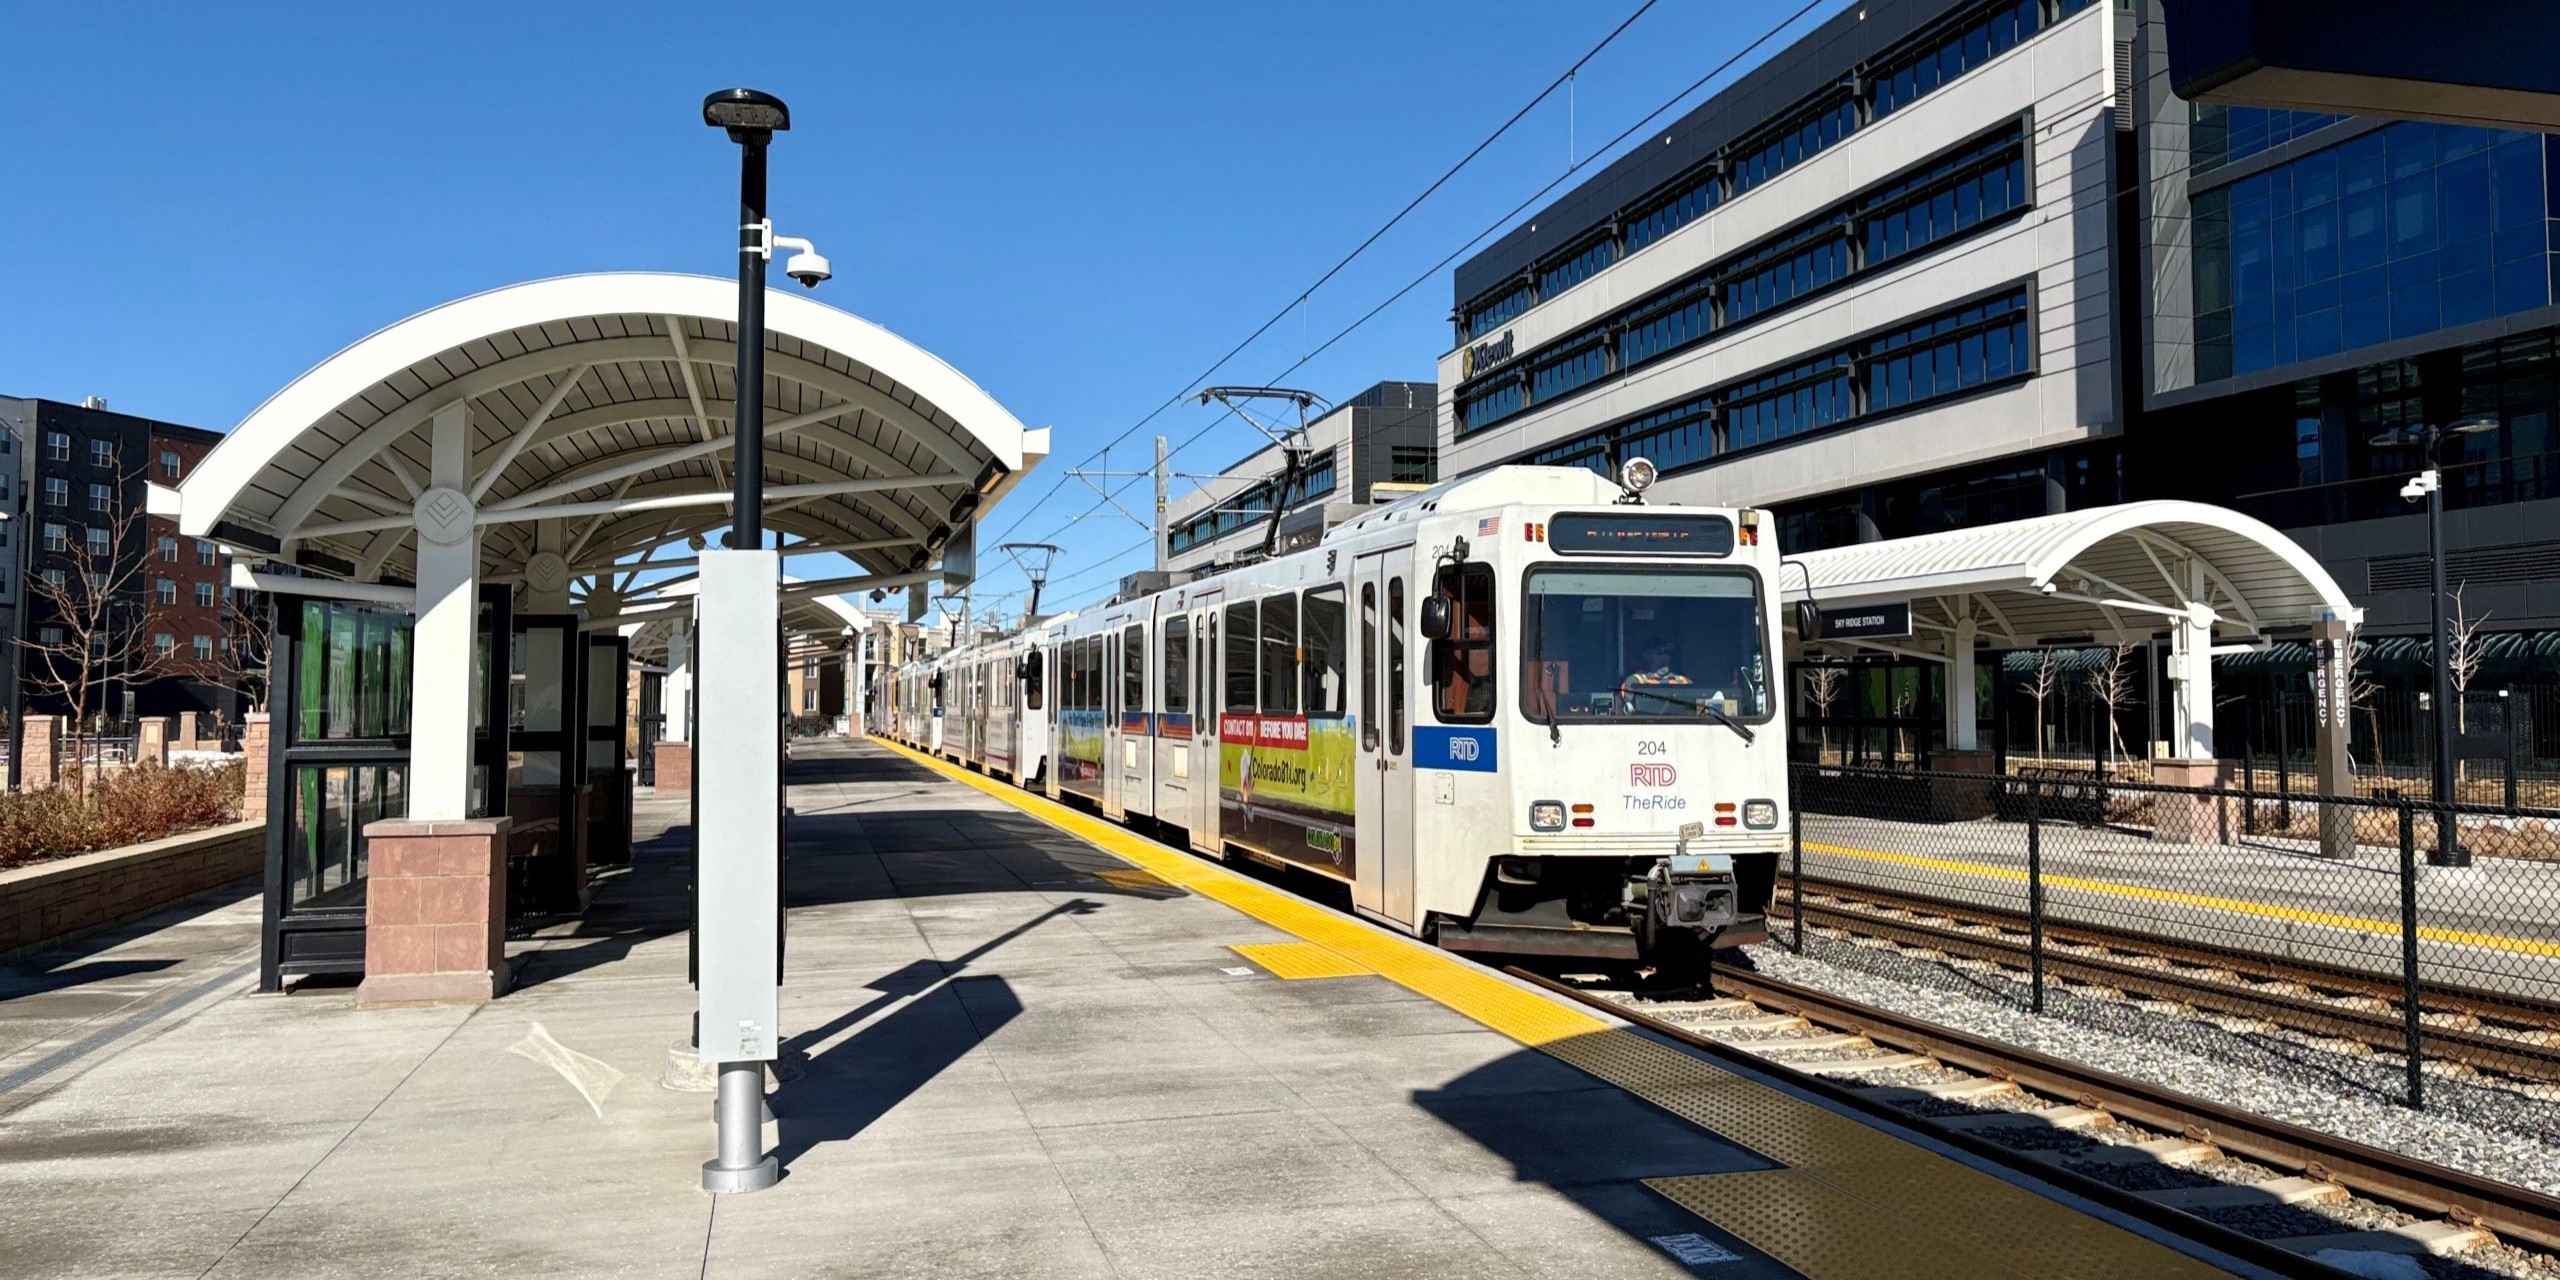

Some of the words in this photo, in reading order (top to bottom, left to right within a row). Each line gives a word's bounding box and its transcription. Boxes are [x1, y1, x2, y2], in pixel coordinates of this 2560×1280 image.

[1431, 544, 1451, 559] 204
[1834, 619, 1844, 629] SKY
[1846, 617, 1861, 628] RIDGE
[1862, 616, 1885, 626] STATION
[2316, 639, 2327, 728] EMERGENCY
[2333, 639, 2346, 728] EMERGENCY
[1223, 719, 1245, 736] CONTACT
[1260, 720, 1281, 738] BEFORE
[1281, 721, 1294, 740] YOU
[1449, 736, 1480, 761] RTD
[1638, 740, 1667, 756] 204
[1630, 763, 1677, 787] RTD
[1622, 795, 1687, 810] TheRide
